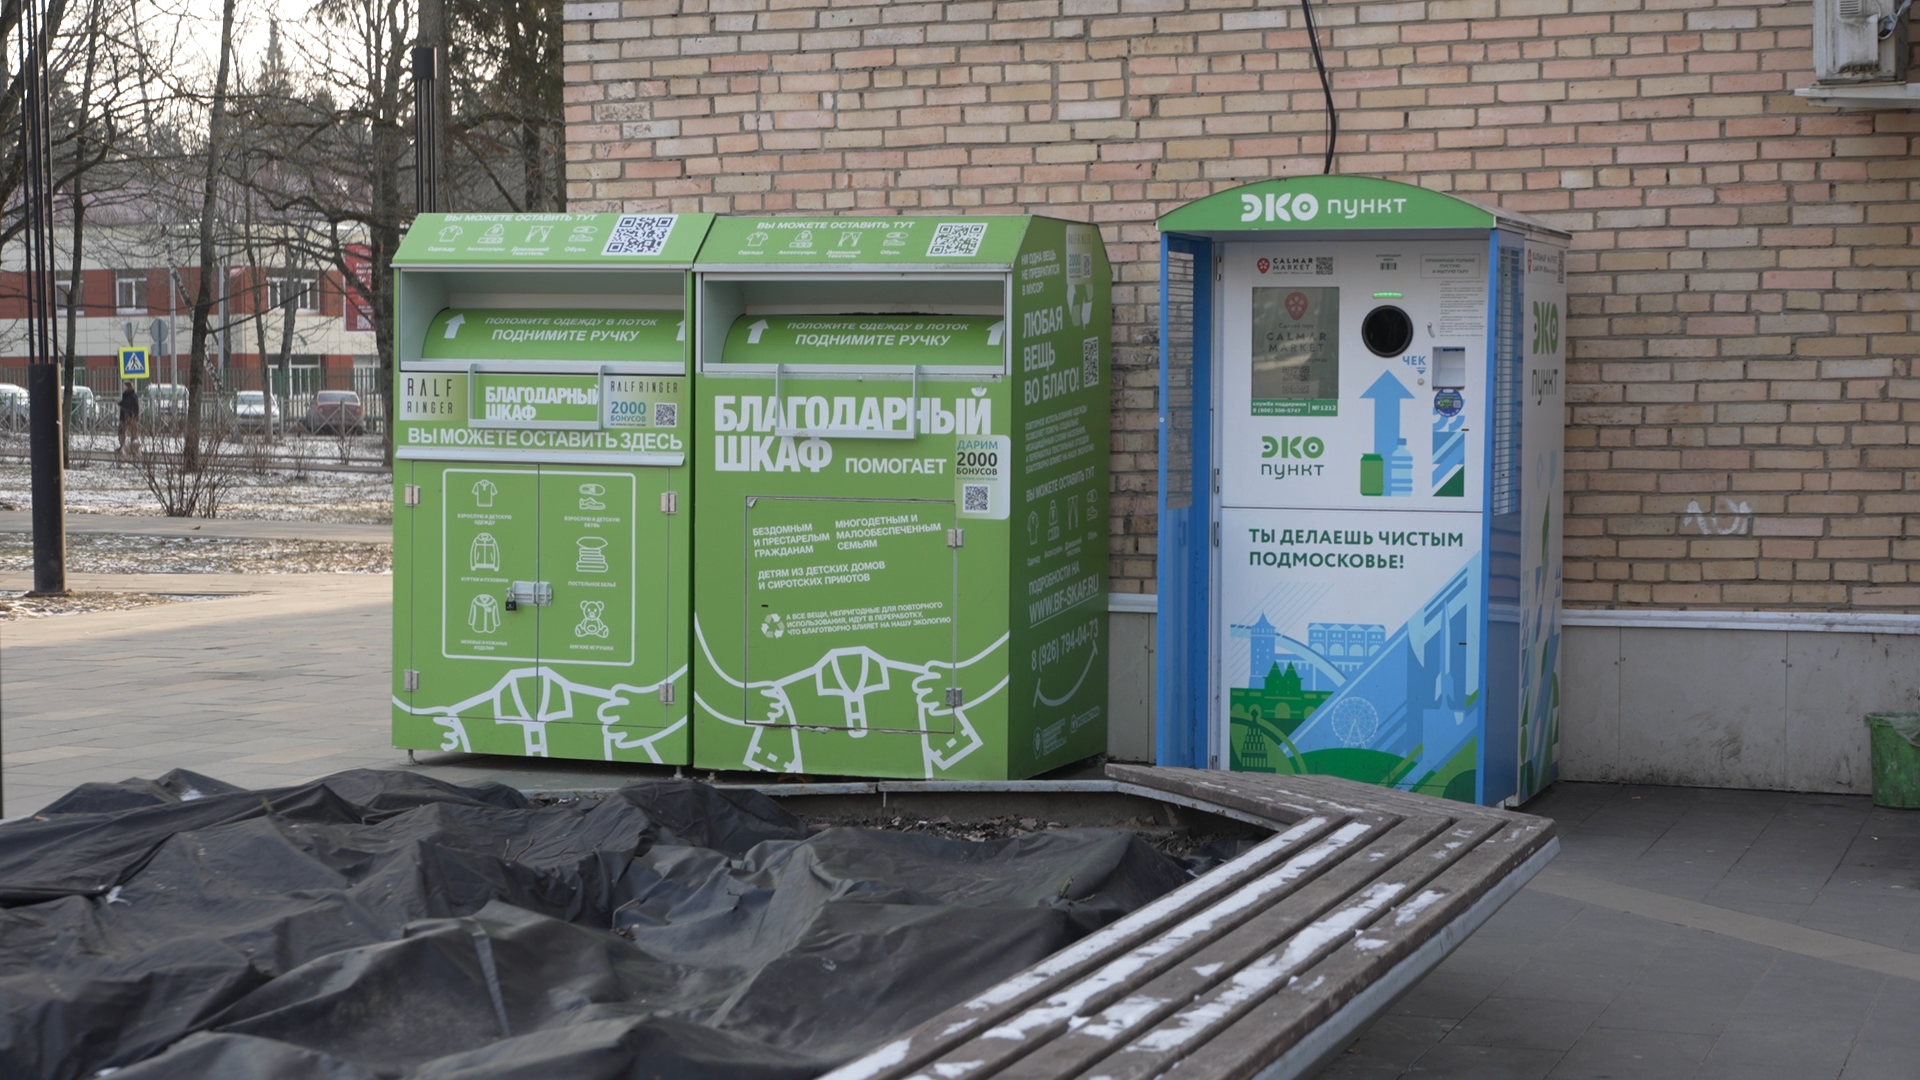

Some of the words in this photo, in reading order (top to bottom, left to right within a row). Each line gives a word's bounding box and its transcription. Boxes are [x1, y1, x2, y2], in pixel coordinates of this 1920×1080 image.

[1241, 193, 1318, 222] ЭКО
[1021, 256, 1028, 265] НИ
[1029, 253, 1042, 264] ОДНА
[1043, 250, 1056, 262] ВЕЩЬ
[1022, 270, 1028, 280] НЕ
[1029, 264, 1060, 279] ПРЕВРАТИТСЯ
[1022, 286, 1026, 296] В
[1026, 282, 1044, 295] МУСОР!
[552, 318, 606, 326] ОДЕЖДУ
[618, 318, 658, 326] ЛОТОК
[859, 322, 914, 330] ОДЕЖДУ
[1023, 306, 1063, 339] ЛЮБАЯ
[1533, 301, 1558, 355] ЭКО
[492, 330, 587, 342] ПОДНИМИТЕ
[592, 330, 639, 342] РУЧКУ
[796, 334, 895, 346] ПОДНИМИТЕ
[899, 334, 950, 346] РУЧКУ
[1266, 332, 1327, 341] CALMAR
[1268, 343, 1324, 352] MARKET
[1024, 341, 1056, 372] ВЕЩЬ
[1403, 356, 1426, 366] ЧЕК
[408, 378, 452, 397] RALF
[1024, 378, 1040, 406] ВО
[1042, 366, 1080, 400] БЛАГО!
[407, 401, 452, 414] RINGER
[486, 404, 536, 421] ШКАФ
[611, 401, 646, 415] 2000
[714, 386, 992, 434] БЛАГОДАРНЫЙ
[610, 414, 646, 422] БОНУСОВ
[408, 428, 437, 444] ВЫ
[440, 428, 517, 446] МОЖЕТЕ
[520, 430, 618, 448] ОСТАВИТЬ
[620, 432, 682, 451] ЗДЕСЬ
[957, 440, 998, 451] ДАРИМ
[1261, 436, 1324, 459] ЭКО
[715, 436, 832, 473] ШКАФ
[957, 452, 998, 467] 2000
[846, 458, 946, 474] ПОМОГАЕТ
[956, 468, 998, 476] БОНУСОВ
[1026, 488, 1034, 502] ВЫ
[1036, 479, 1058, 498] МОЖЕТЕ
[1059, 470, 1084, 490] ОСТАВИТЬ
[1085, 465, 1095, 480] ТУТ
[836, 516, 908, 529] МНОГОДЕТНЫМ
[911, 514, 918, 522] И
[753, 524, 812, 536] БЕЗДОМНЫМ
[836, 524, 942, 540] МАЛООБЕСПЕЧЕННЫМ
[1249, 528, 1275, 543] ТЫ
[1280, 530, 1374, 545] ДЕЛАЕШЬ
[1378, 531, 1463, 547] ЧИСТЫМ
[763, 533, 830, 546] ПРЕСТАРЕЛЫМ
[838, 540, 878, 550] СЕМЬЯМ
[755, 546, 814, 558] ГРАЖДАНАМ
[1250, 552, 1404, 569] ПОДМОСКОВЬЕ!
[758, 570, 789, 580] ДЕТЯМ
[792, 568, 804, 577] ИЗ
[806, 564, 848, 576] ДЕТСКИХ
[851, 561, 886, 573] ДОМОВ
[1029, 566, 1070, 595] ПОДРОБНОСТИ
[1071, 561, 1080, 574] НА
[758, 582, 765, 590] И
[768, 578, 823, 590] СИРОТСКИХ
[825, 574, 870, 585] ПРИЮТОВ
[1029, 573, 1099, 624] WWW.BF-SKAF.RU
[830, 608, 880, 617] НЕПРИГОДНЫЕ
[898, 602, 943, 612] ПОВТОРНОГО
[802, 625, 850, 635] БЛАГОТВОРНО
[913, 617, 952, 626] ЭКОЛОГИЮ
[1031, 650, 1037, 671] 8
[1038, 638, 1060, 672] (926)
[1061, 618, 1098, 655] 794-04-73
